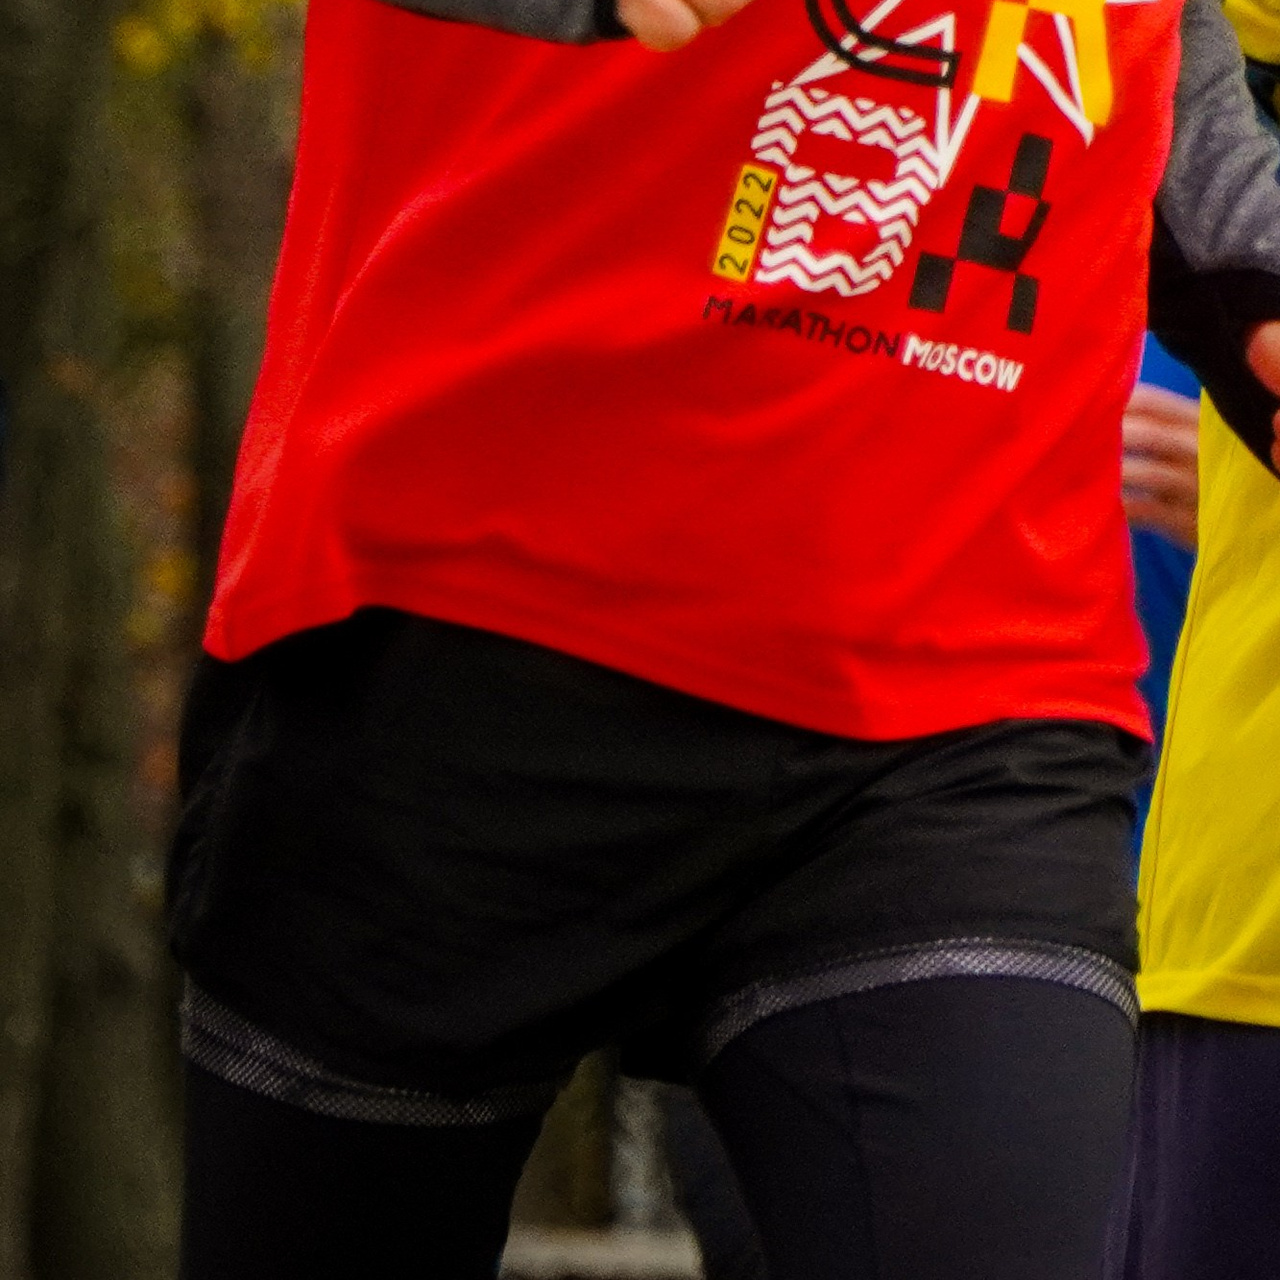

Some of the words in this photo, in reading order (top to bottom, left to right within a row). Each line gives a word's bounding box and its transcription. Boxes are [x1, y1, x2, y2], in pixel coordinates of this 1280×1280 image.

[718, 172, 773, 276] 2022
[703, 296, 900, 357] MARATHON
[902, 334, 1024, 392] MOSCOW
